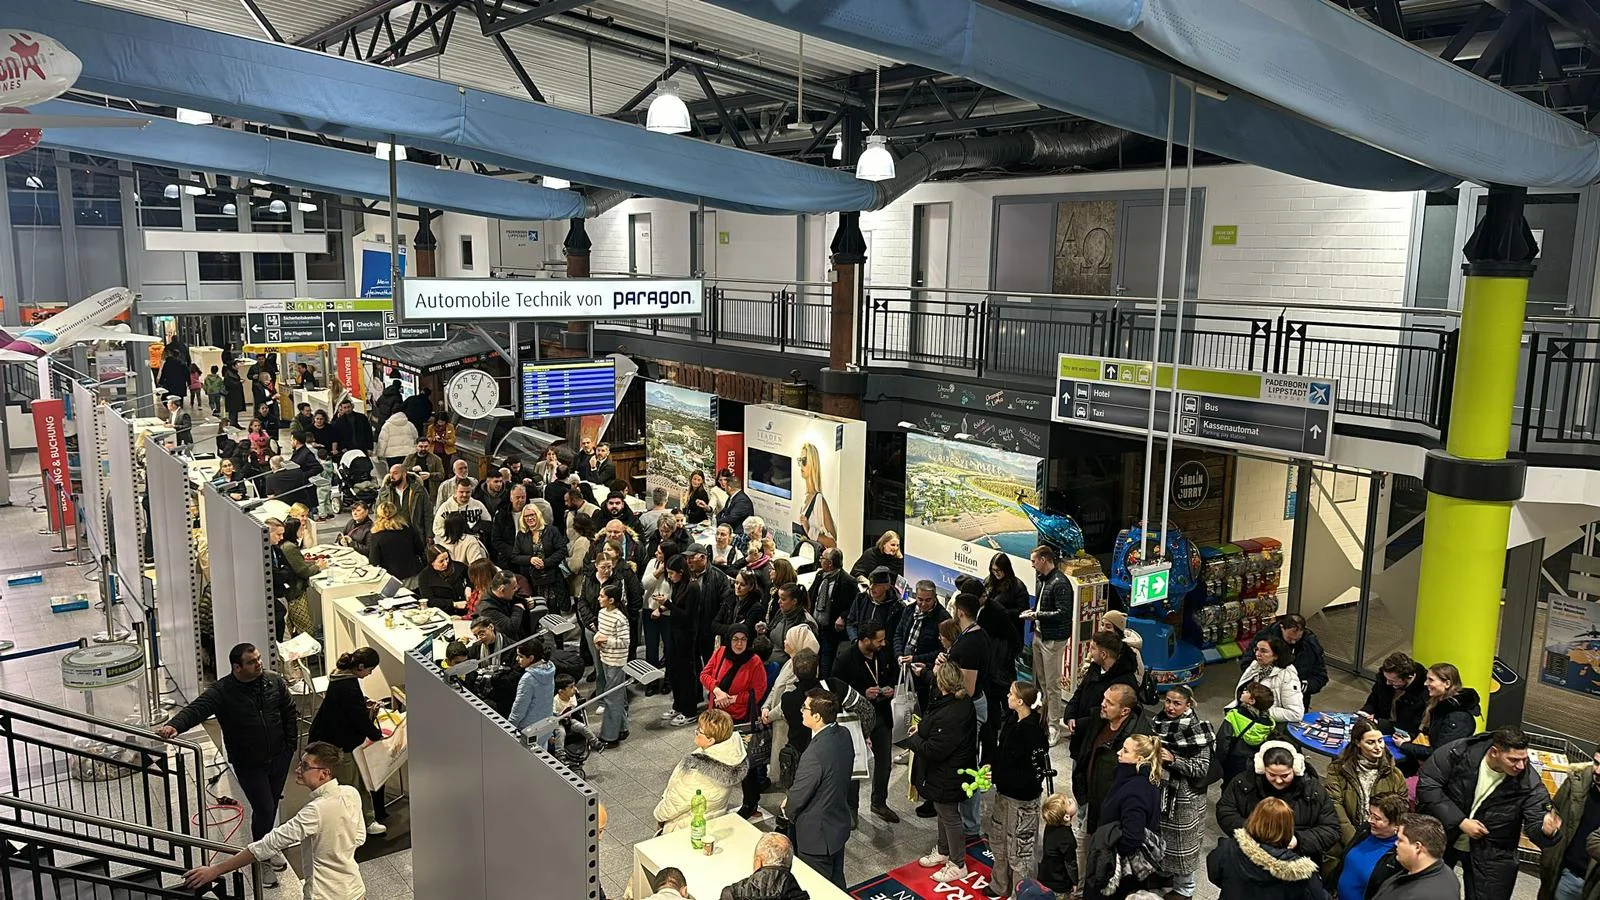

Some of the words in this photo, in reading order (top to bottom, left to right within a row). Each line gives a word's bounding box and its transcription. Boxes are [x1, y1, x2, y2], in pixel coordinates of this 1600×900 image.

[0, 79, 21, 92] NES
[365, 290, 392, 298] Heimatha
[415, 290, 510, 309] Automobile
[517, 290, 572, 308] Technik
[577, 292, 602, 306] von
[1266, 378, 1308, 389] PADERBORN
[1094, 389, 1110, 398] Hotel
[1268, 386, 1307, 397] LIPPSTADT
[1093, 408, 1105, 417] Taxi
[1204, 402, 1219, 412] Bus
[1203, 420, 1259, 436] Kassenautomat
[45, 416, 60, 458] BUCHUNG
[954, 551, 978, 567] Hilton
